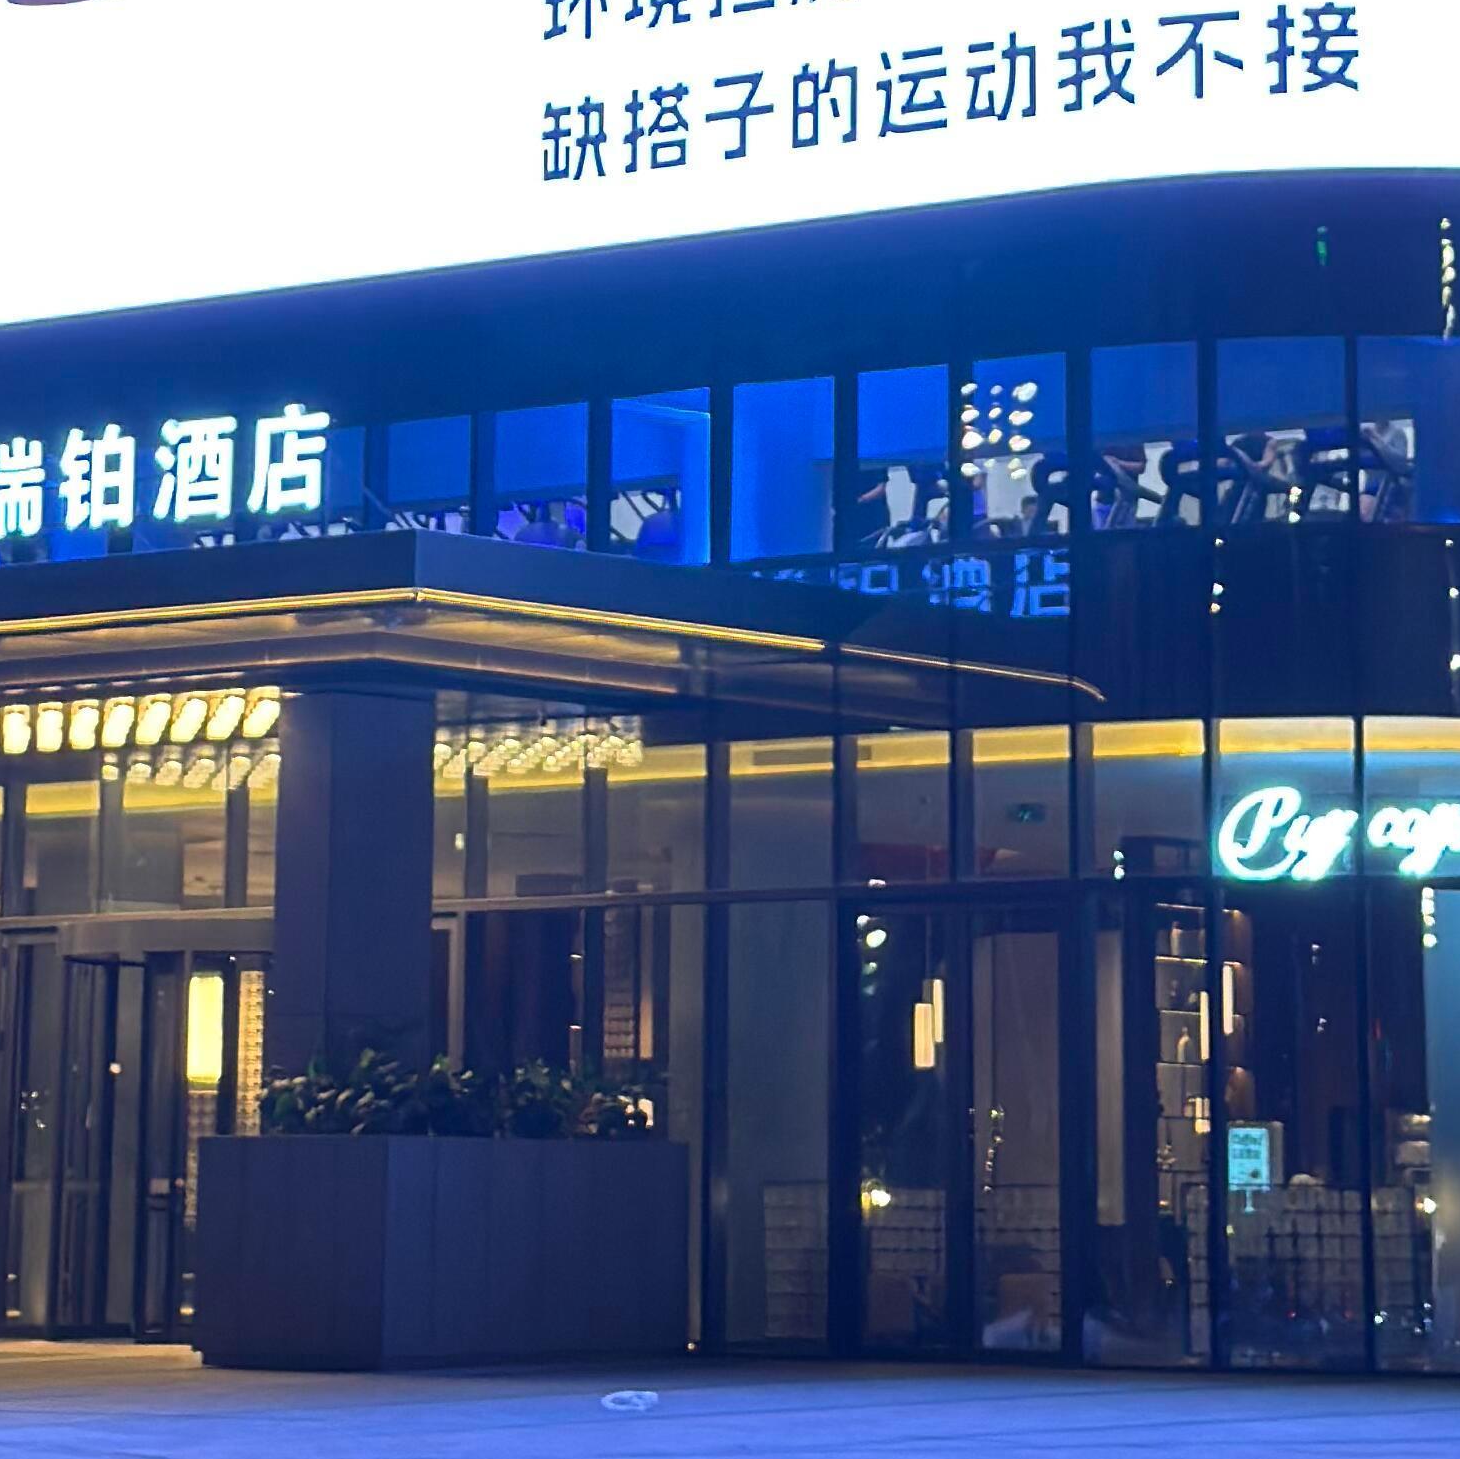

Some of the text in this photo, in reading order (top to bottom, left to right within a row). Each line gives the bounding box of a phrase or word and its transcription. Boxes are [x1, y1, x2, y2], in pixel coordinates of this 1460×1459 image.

[541, 1, 1359, 182] 缺搭子的运动我不接
